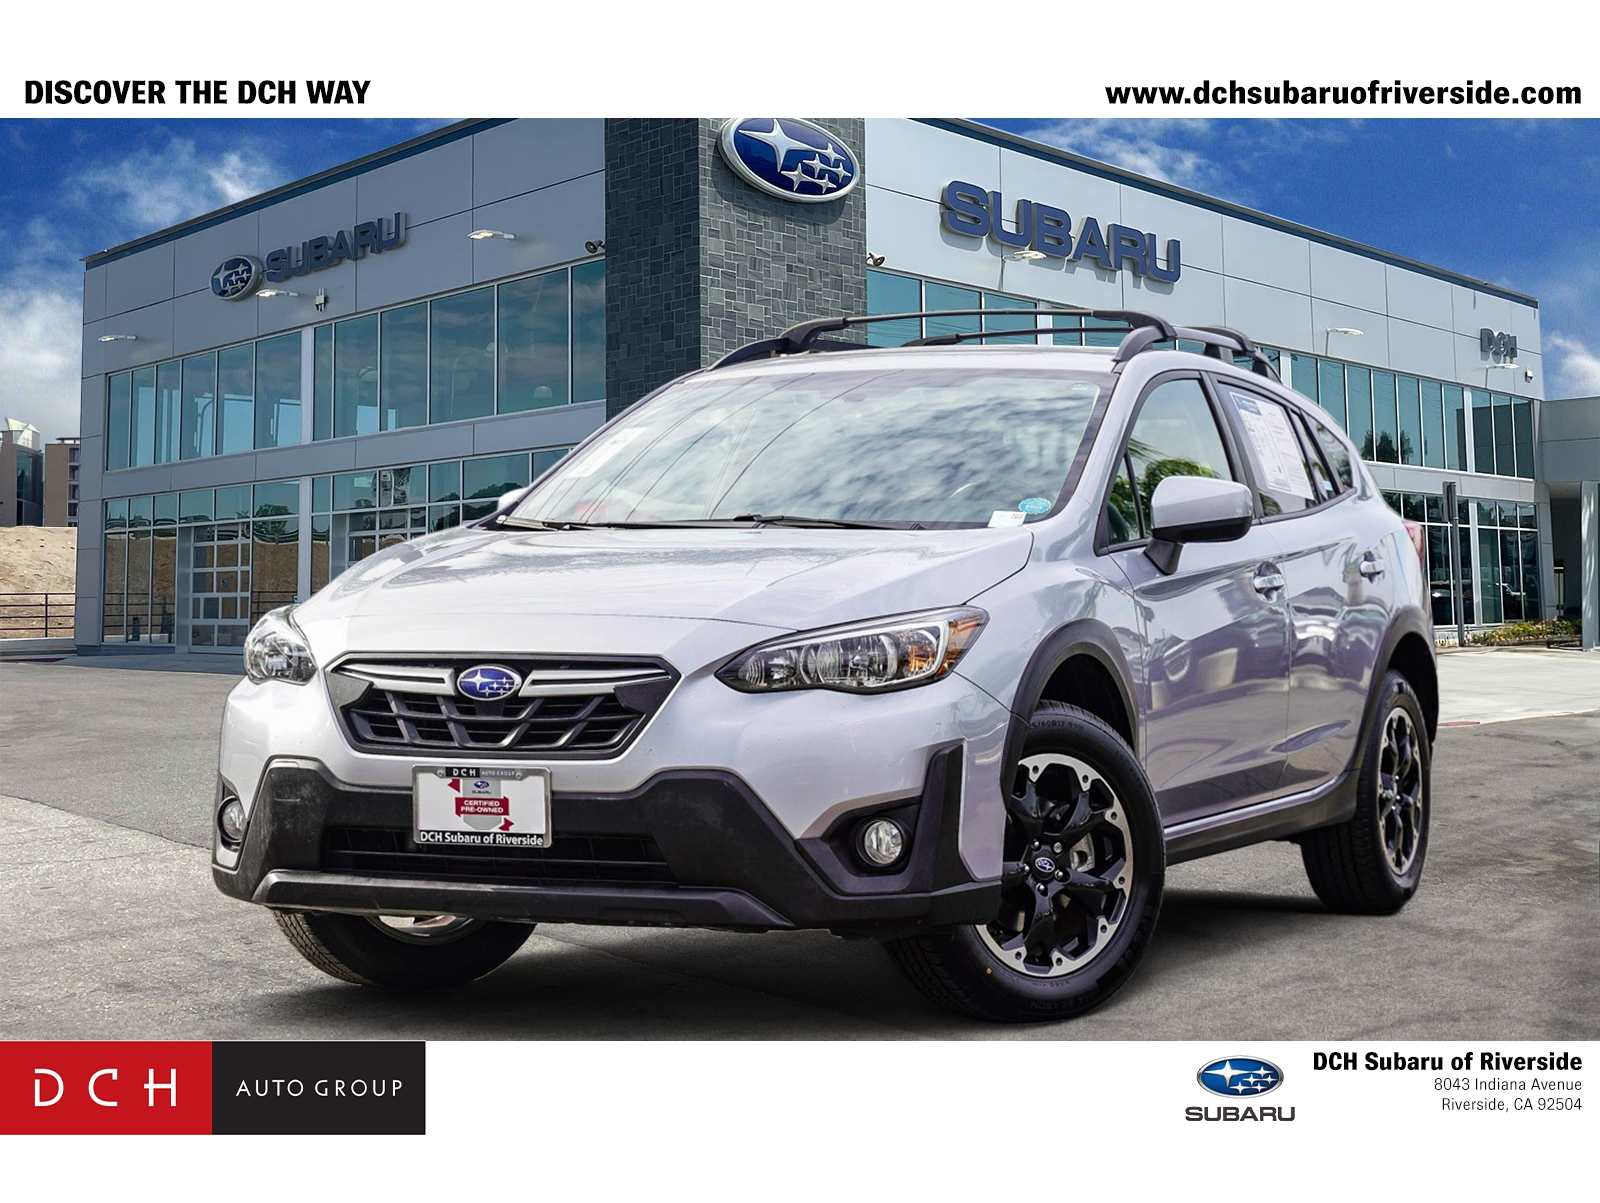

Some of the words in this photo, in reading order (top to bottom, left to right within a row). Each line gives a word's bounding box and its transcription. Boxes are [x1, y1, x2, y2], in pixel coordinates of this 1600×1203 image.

[940, 180, 1181, 283] SUBARU
[265, 212, 406, 283] SUBARU
[452, 768, 476, 777] DCH
[463, 799, 500, 807] CERTIFIED
[460, 806, 504, 814] PRE-OWNED
[420, 831, 443, 842] DCH
[444, 831, 482, 844] Subaru
[483, 832, 494, 844] of
[495, 834, 544, 846] Riverside
